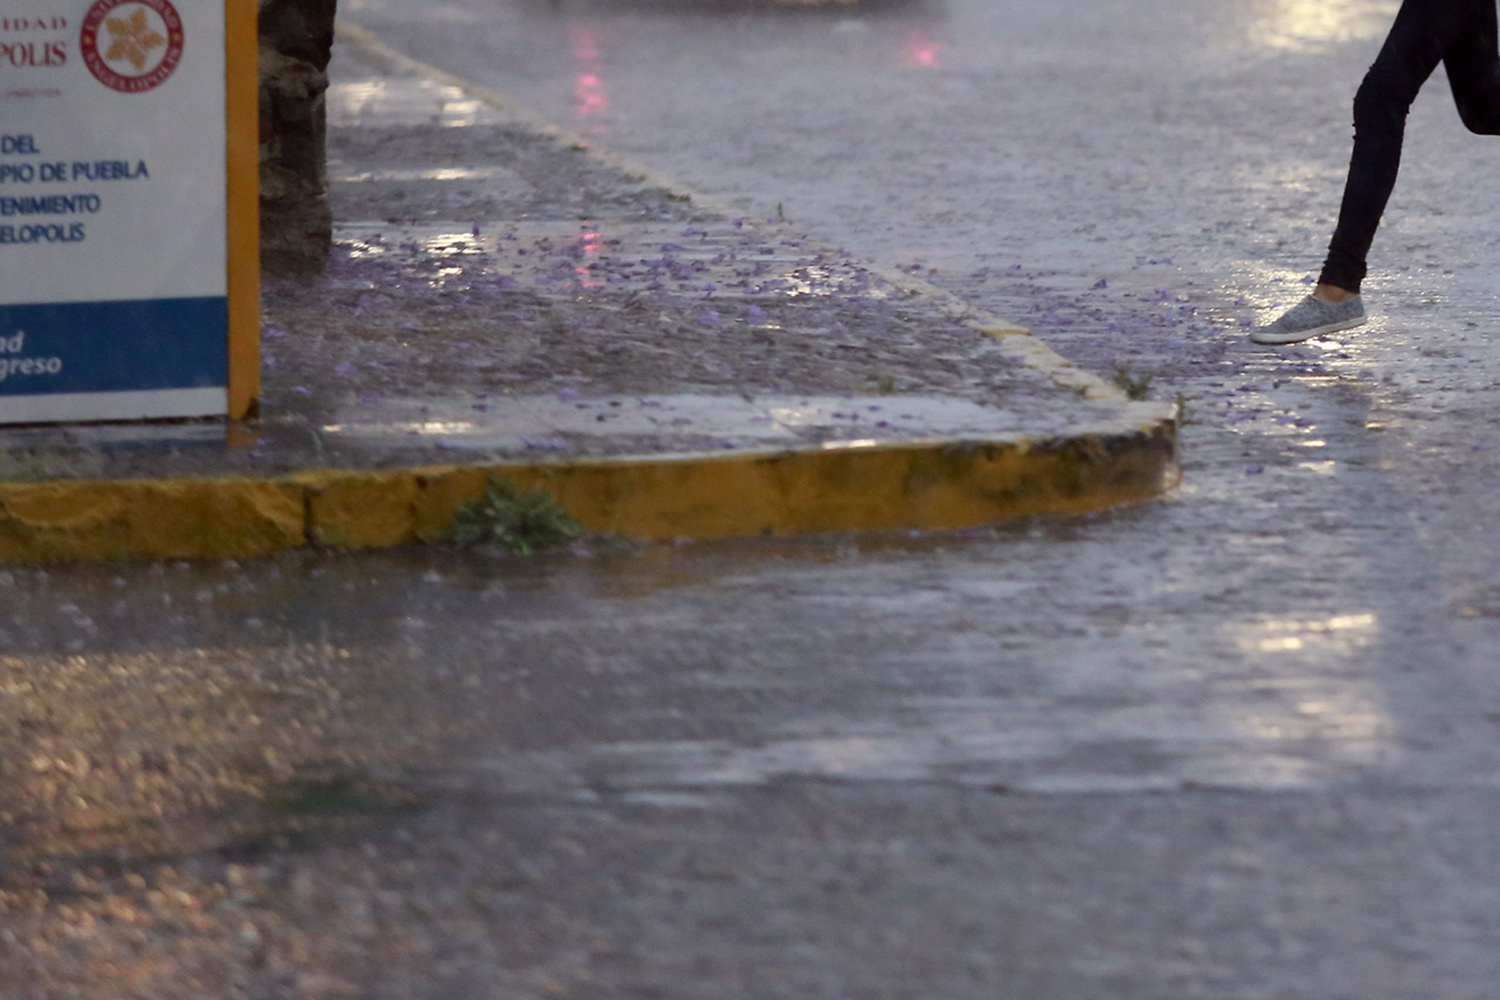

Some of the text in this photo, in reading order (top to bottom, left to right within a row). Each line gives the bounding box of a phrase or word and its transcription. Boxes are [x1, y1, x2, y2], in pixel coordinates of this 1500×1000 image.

[2, 16, 67, 31] IDAD
[1, 135, 40, 154] DEL
[40, 162, 66, 181] DE
[72, 160, 149, 181] PUEBLA
